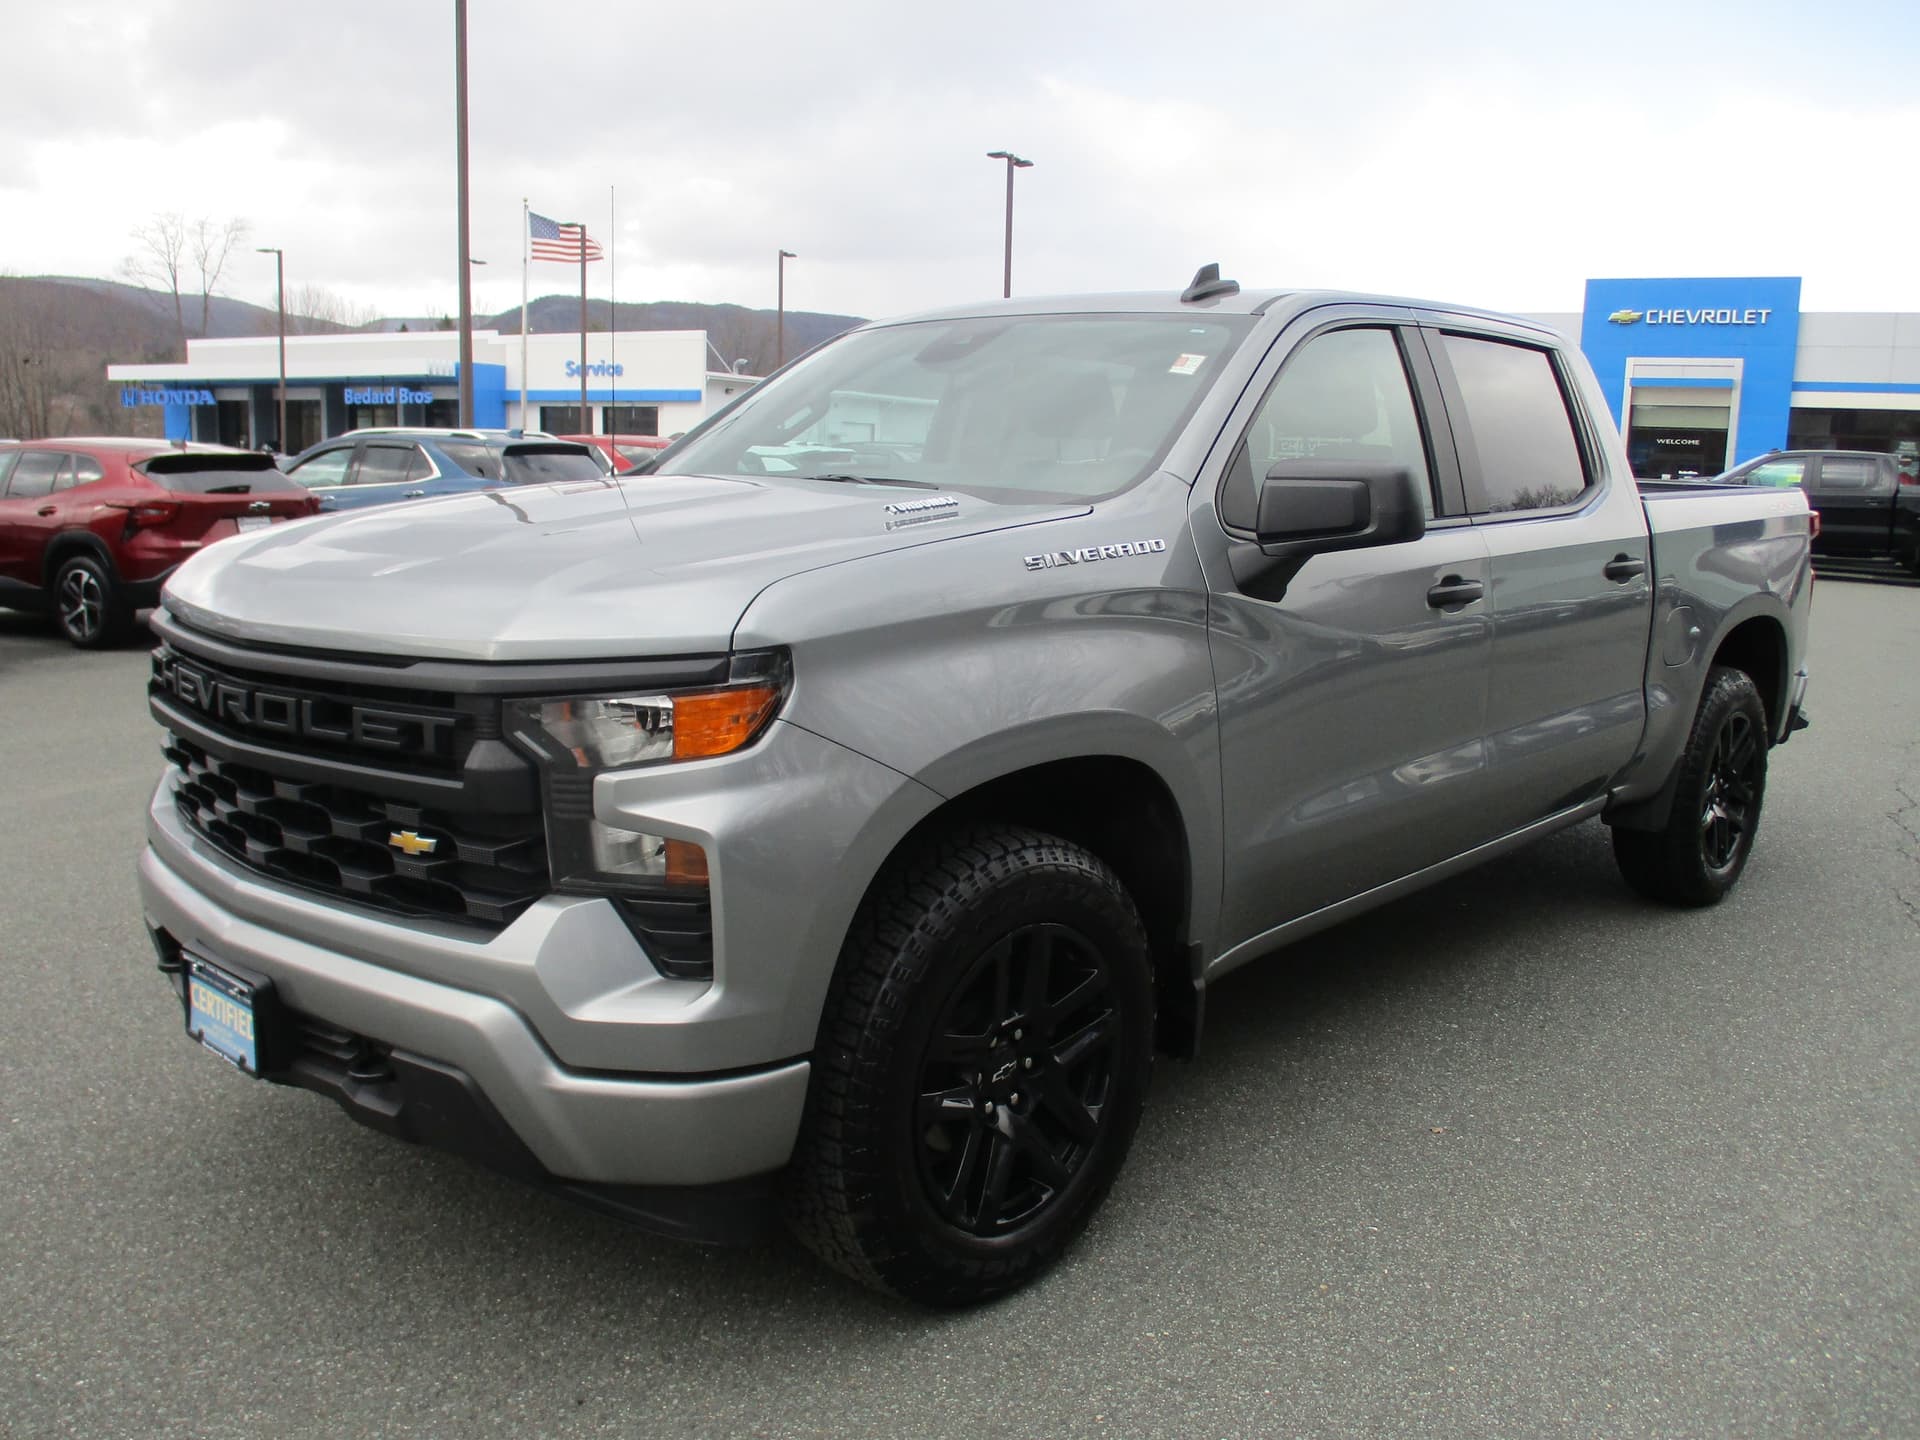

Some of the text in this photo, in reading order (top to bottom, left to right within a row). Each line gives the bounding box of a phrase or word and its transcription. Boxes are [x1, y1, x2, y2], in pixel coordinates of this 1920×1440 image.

[1645, 309, 1772, 324] CHEVROLET
[565, 360, 623, 377] Service
[141, 390, 217, 405] HONDA
[344, 387, 433, 405] Bedard Bros
[1656, 438, 1700, 446] WELCOME
[1024, 538, 1166, 571] SILVERADO
[151, 650, 456, 751] CHEVROLET
